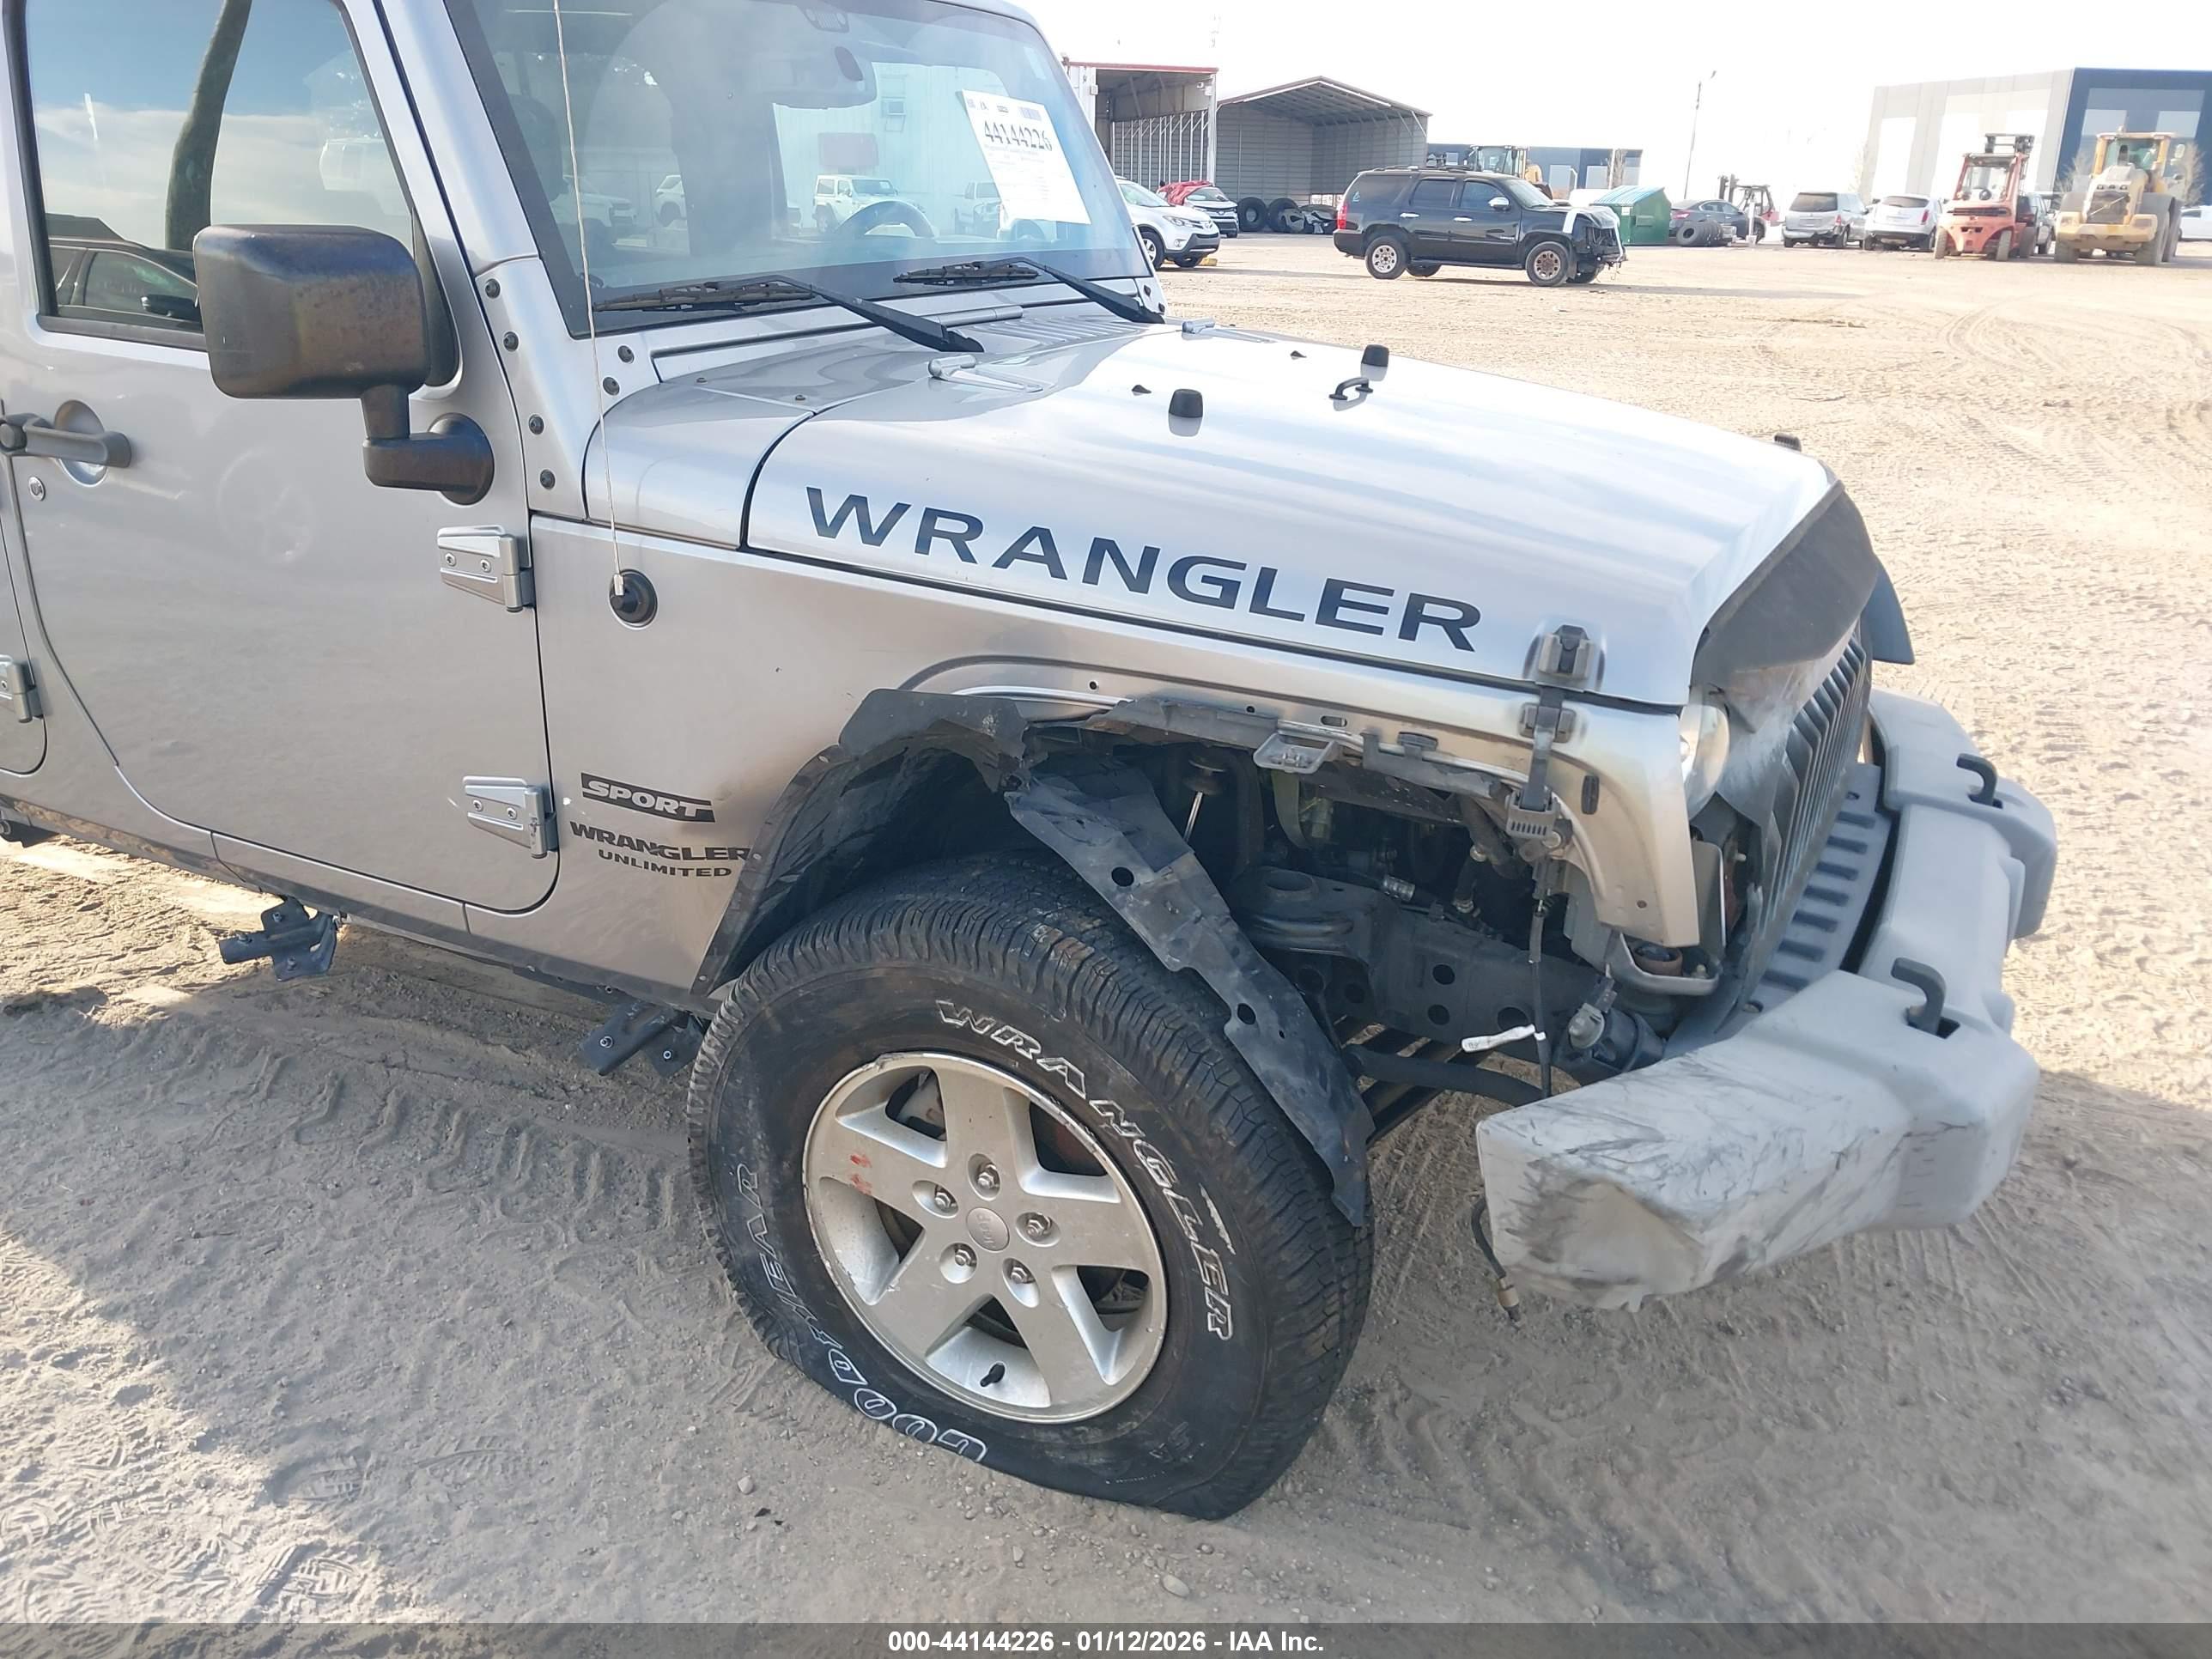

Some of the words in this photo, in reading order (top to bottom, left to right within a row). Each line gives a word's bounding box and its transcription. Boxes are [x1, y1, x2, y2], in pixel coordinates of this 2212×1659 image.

[984, 120, 1053, 151] 44144226
[805, 486, 1481, 652] WRANGLER
[582, 780, 713, 817] SPORT
[569, 821, 750, 861] WRANGLER
[598, 849, 732, 878] UNLIMITED
[935, 999, 1234, 1340] WRANGLER
